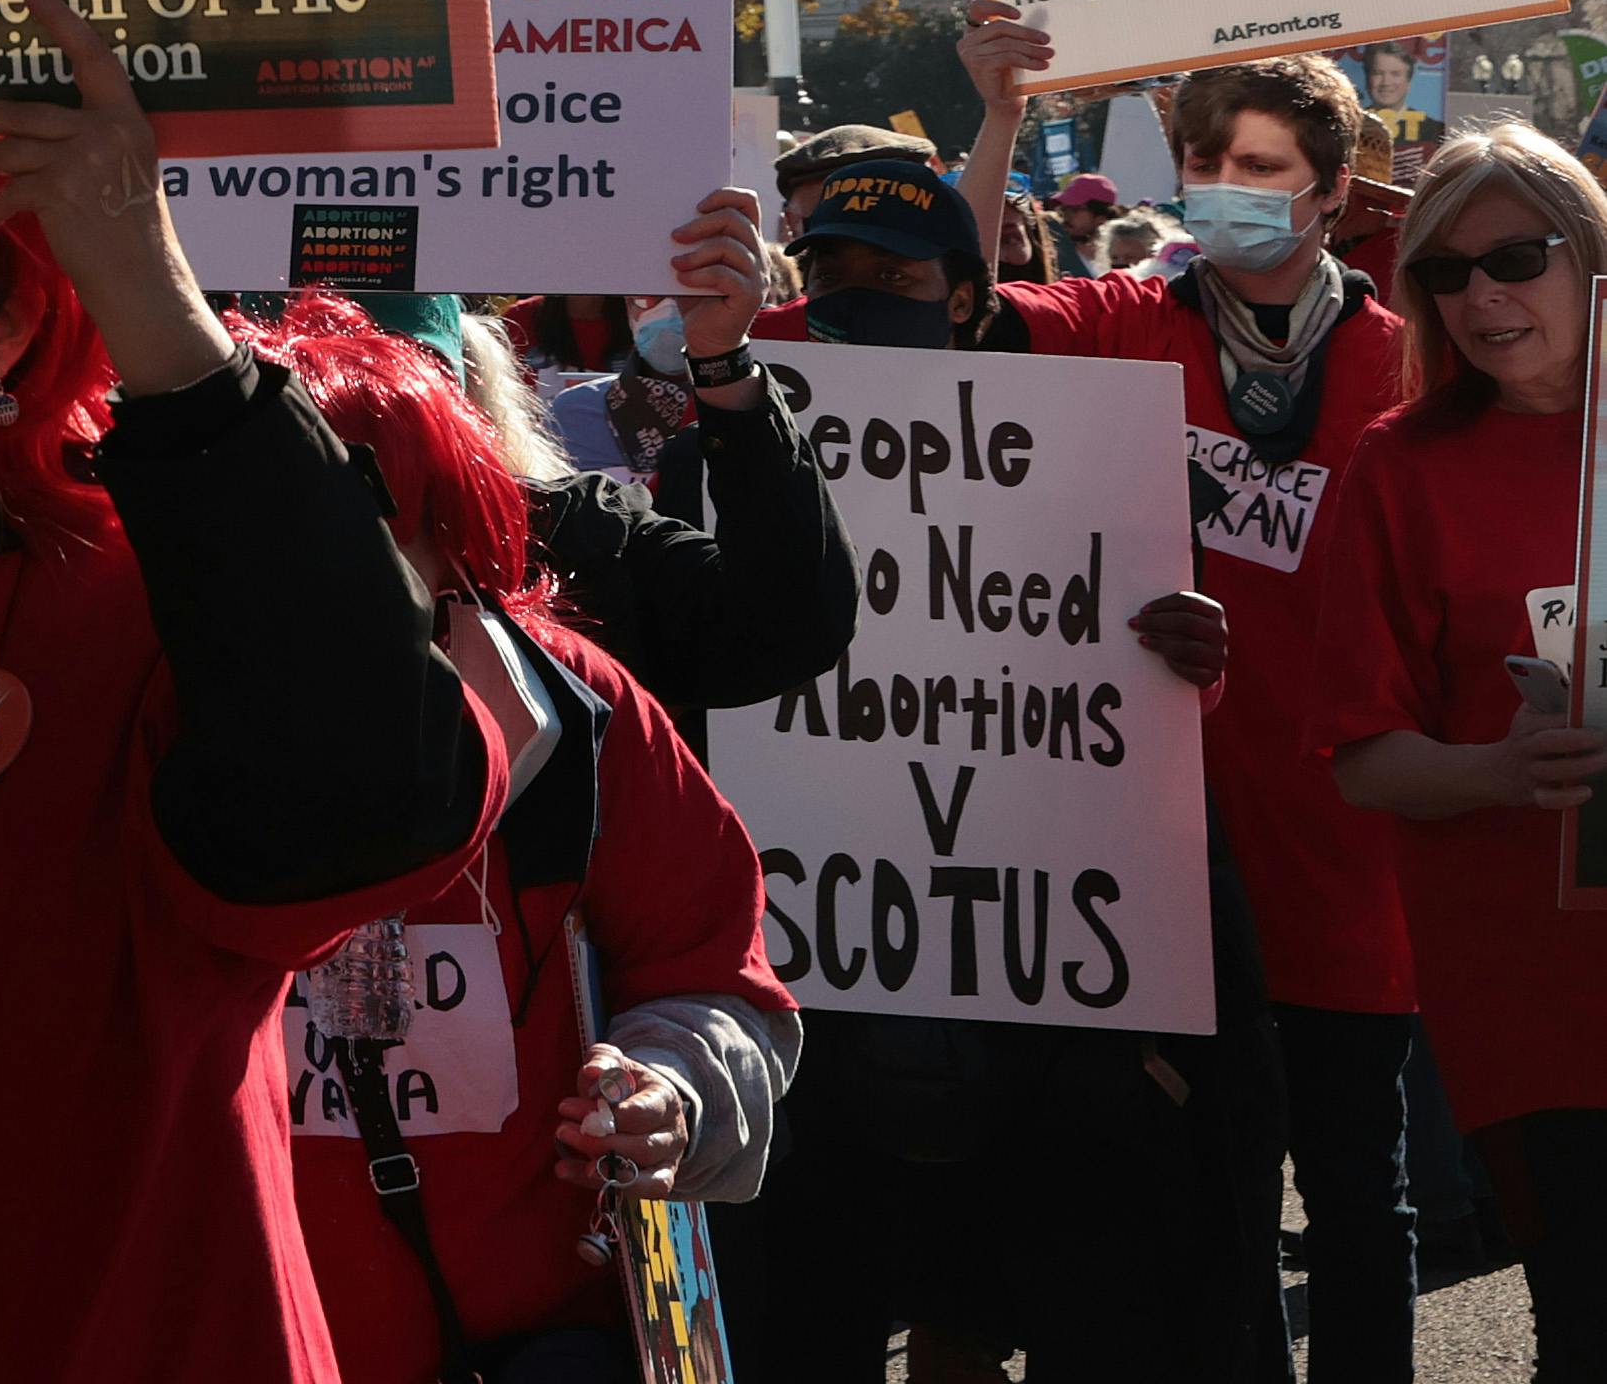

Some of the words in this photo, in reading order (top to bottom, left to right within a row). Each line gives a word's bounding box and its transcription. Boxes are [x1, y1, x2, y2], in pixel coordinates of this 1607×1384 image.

[493, 18, 702, 55] AMERICA
[1212, 11, 1343, 46] AAFront.org
[255, 55, 414, 83] ABORTION
[498, 81, 622, 124] oice
[163, 166, 188, 198] a
[209, 154, 462, 198] woman's
[481, 153, 616, 208] right
[303, 209, 394, 223] ABORTION
[843, 195, 880, 212] AF
[301, 243, 393, 257] ABORTION
[302, 226, 394, 240] ABORTION
[300, 260, 393, 274] ABORTION
[927, 524, 1103, 645] Need
[907, 760, 977, 856] V
[761, 847, 1130, 1009] SCOTUS
